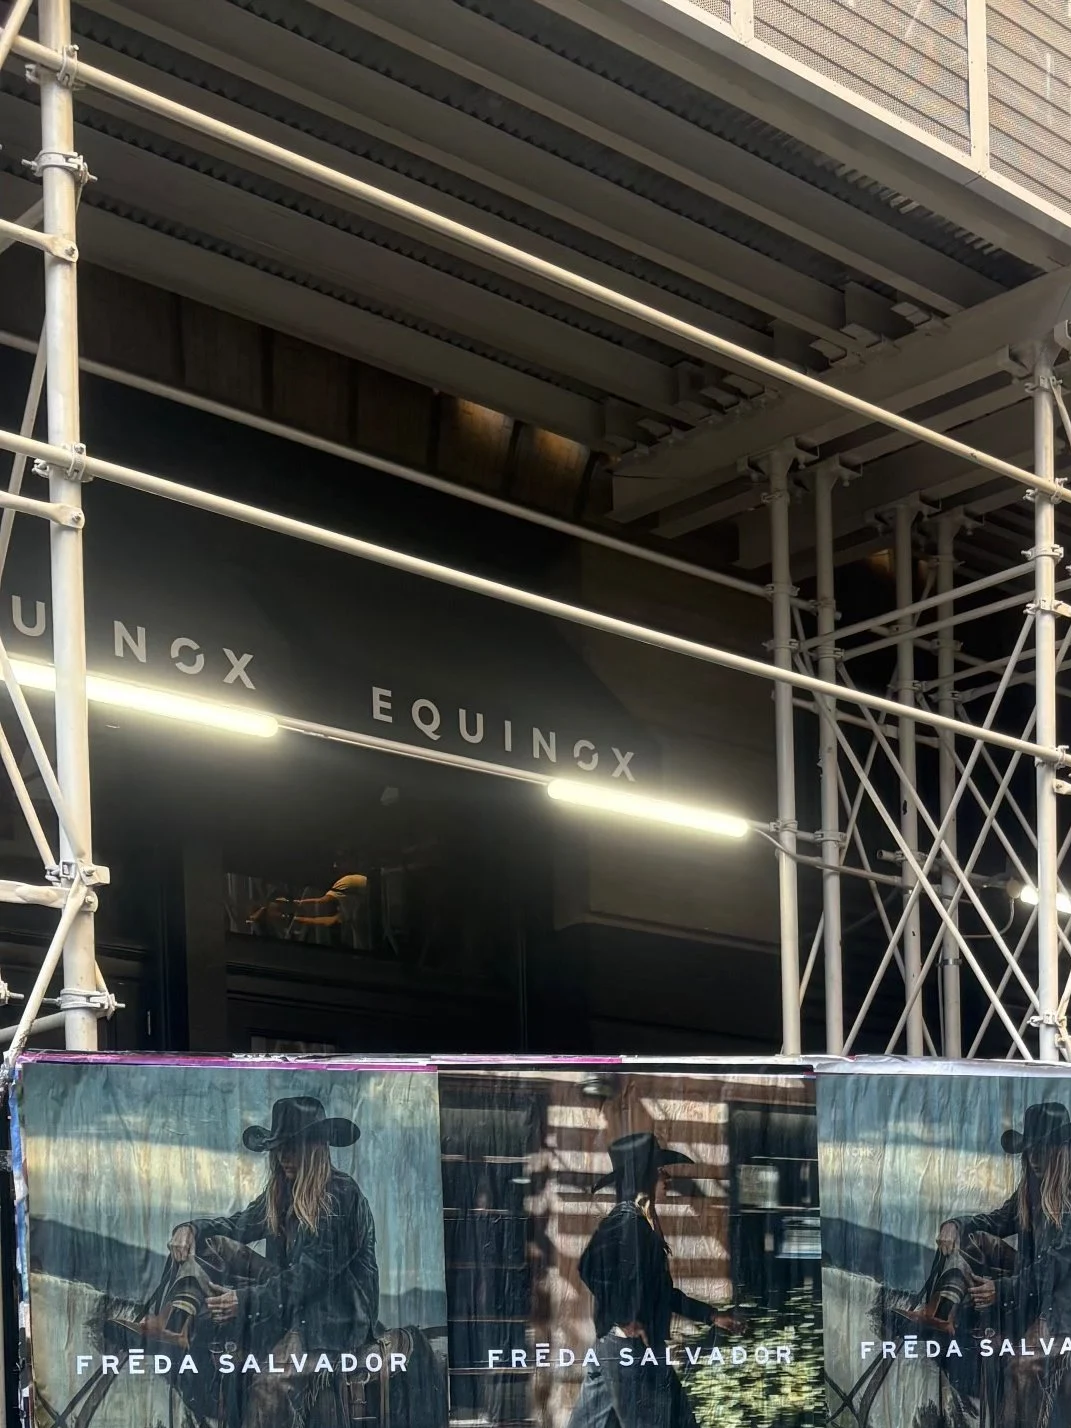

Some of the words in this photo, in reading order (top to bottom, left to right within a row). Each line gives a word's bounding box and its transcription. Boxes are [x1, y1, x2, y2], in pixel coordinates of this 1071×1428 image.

[372, 686, 636, 782] EQUINOX
[219, 1351, 408, 1374] SALVADOR
[619, 1345, 792, 1367] SALVADOR
